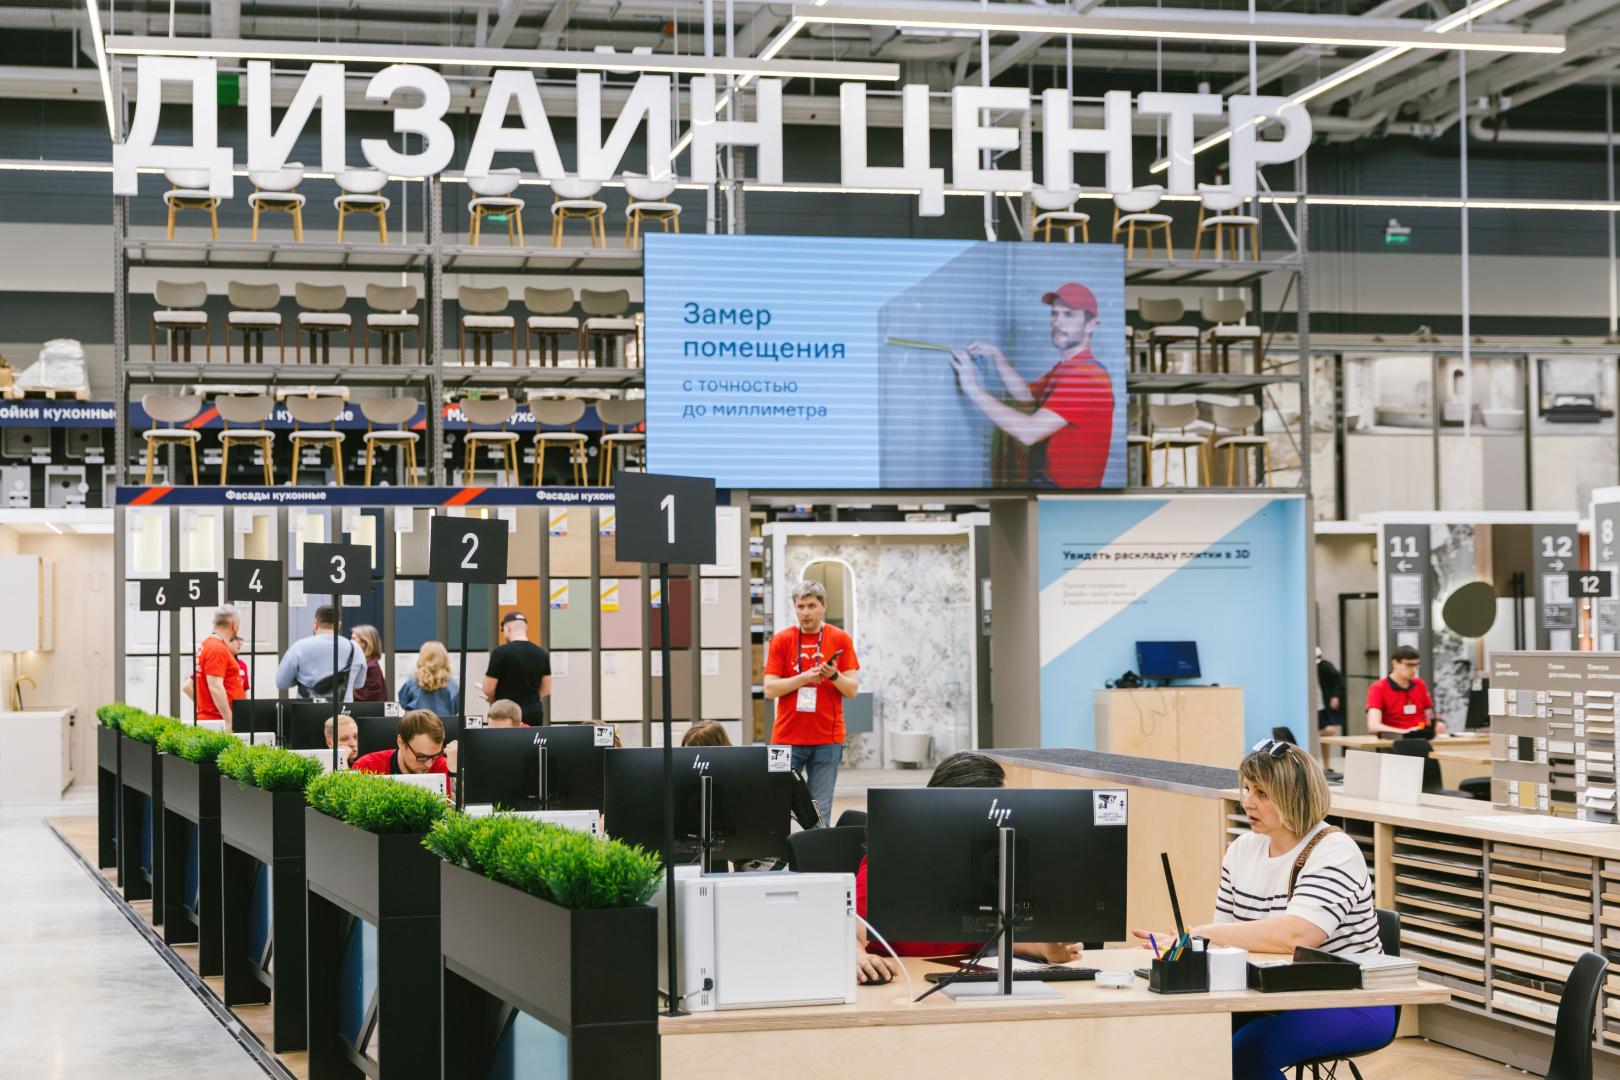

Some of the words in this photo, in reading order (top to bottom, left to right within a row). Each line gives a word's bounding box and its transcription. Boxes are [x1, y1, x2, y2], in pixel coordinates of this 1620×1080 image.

[113, 46, 783, 198] ДИЗАЙН
[840, 82, 1312, 216] ЦЕНТР
[683, 302, 772, 331] Замер
[683, 340, 847, 362] помещения
[682, 380, 693, 392] с
[698, 380, 798, 393] точностью
[0, 406, 39, 419] ойки
[43, 409, 116, 422] кухонны
[682, 404, 706, 418] до
[712, 404, 828, 420] миллиметра
[225, 490, 270, 501] Фасады
[272, 491, 327, 502] кухонные
[536, 490, 579, 502] Фасады
[581, 492, 615, 502] кухон
[660, 494, 676, 544] 1
[1601, 519, 1614, 544] 8
[460, 533, 479, 569] 2
[1063, 550, 1111, 561] Увидеть
[1115, 550, 1178, 562] раскладку
[1180, 550, 1222, 560] плитки
[1235, 550, 1250, 560] 3D
[1389, 536, 1420, 558] 11
[1541, 536, 1573, 558] 12
[249, 568, 263, 593] 4
[330, 555, 346, 584] 3
[188, 579, 201, 600] 5
[1580, 575, 1600, 593] 12
[155, 586, 166, 605] 6
[693, 754, 710, 773] hp
[988, 799, 1011, 827] hp
